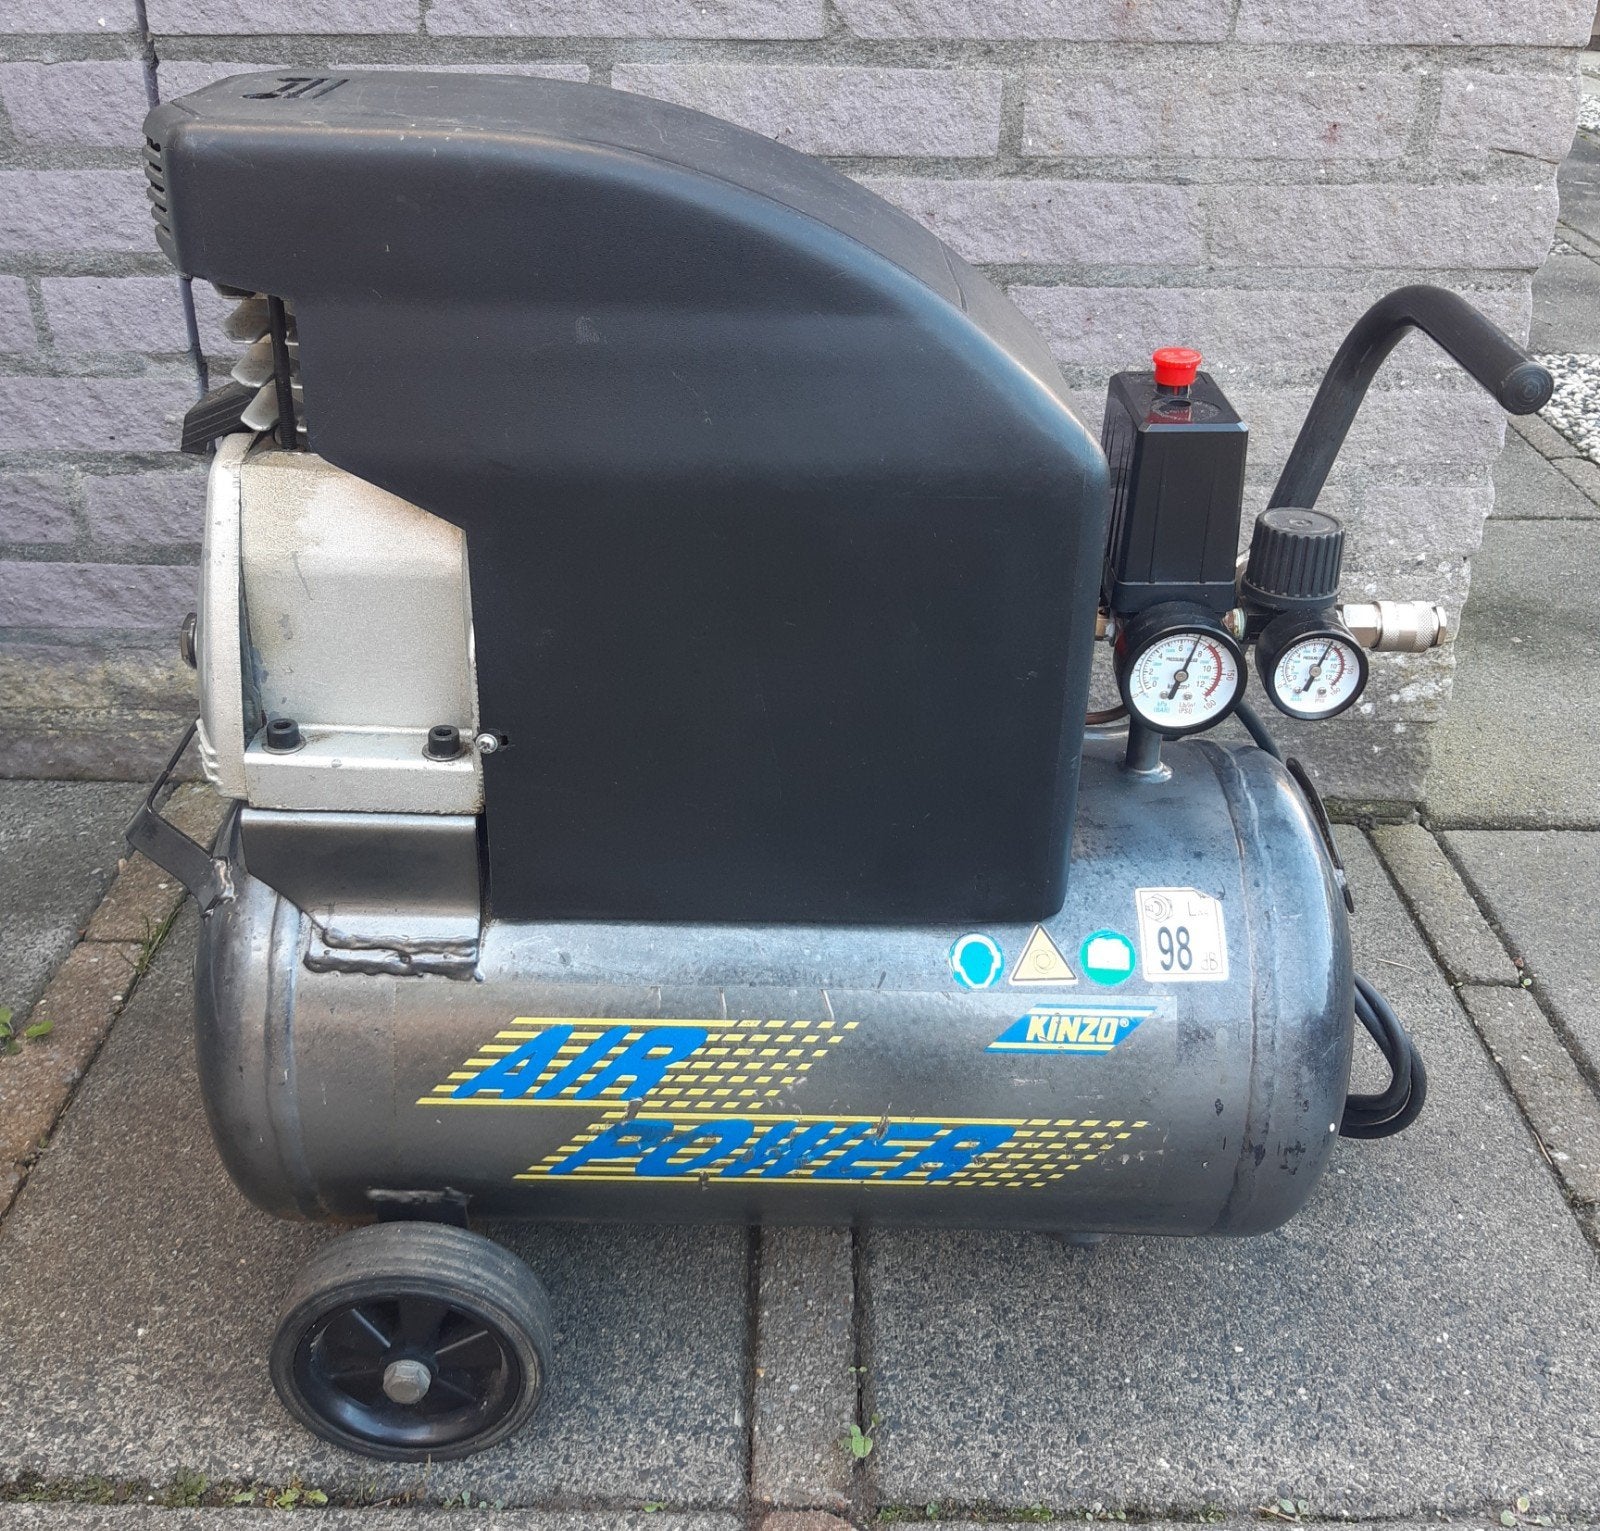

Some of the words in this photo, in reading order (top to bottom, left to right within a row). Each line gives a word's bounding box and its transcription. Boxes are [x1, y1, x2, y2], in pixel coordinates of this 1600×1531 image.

[1157, 925, 1193, 972] 98
[450, 1024, 710, 1101] AIR
[547, 1118, 1016, 1180] POWER
